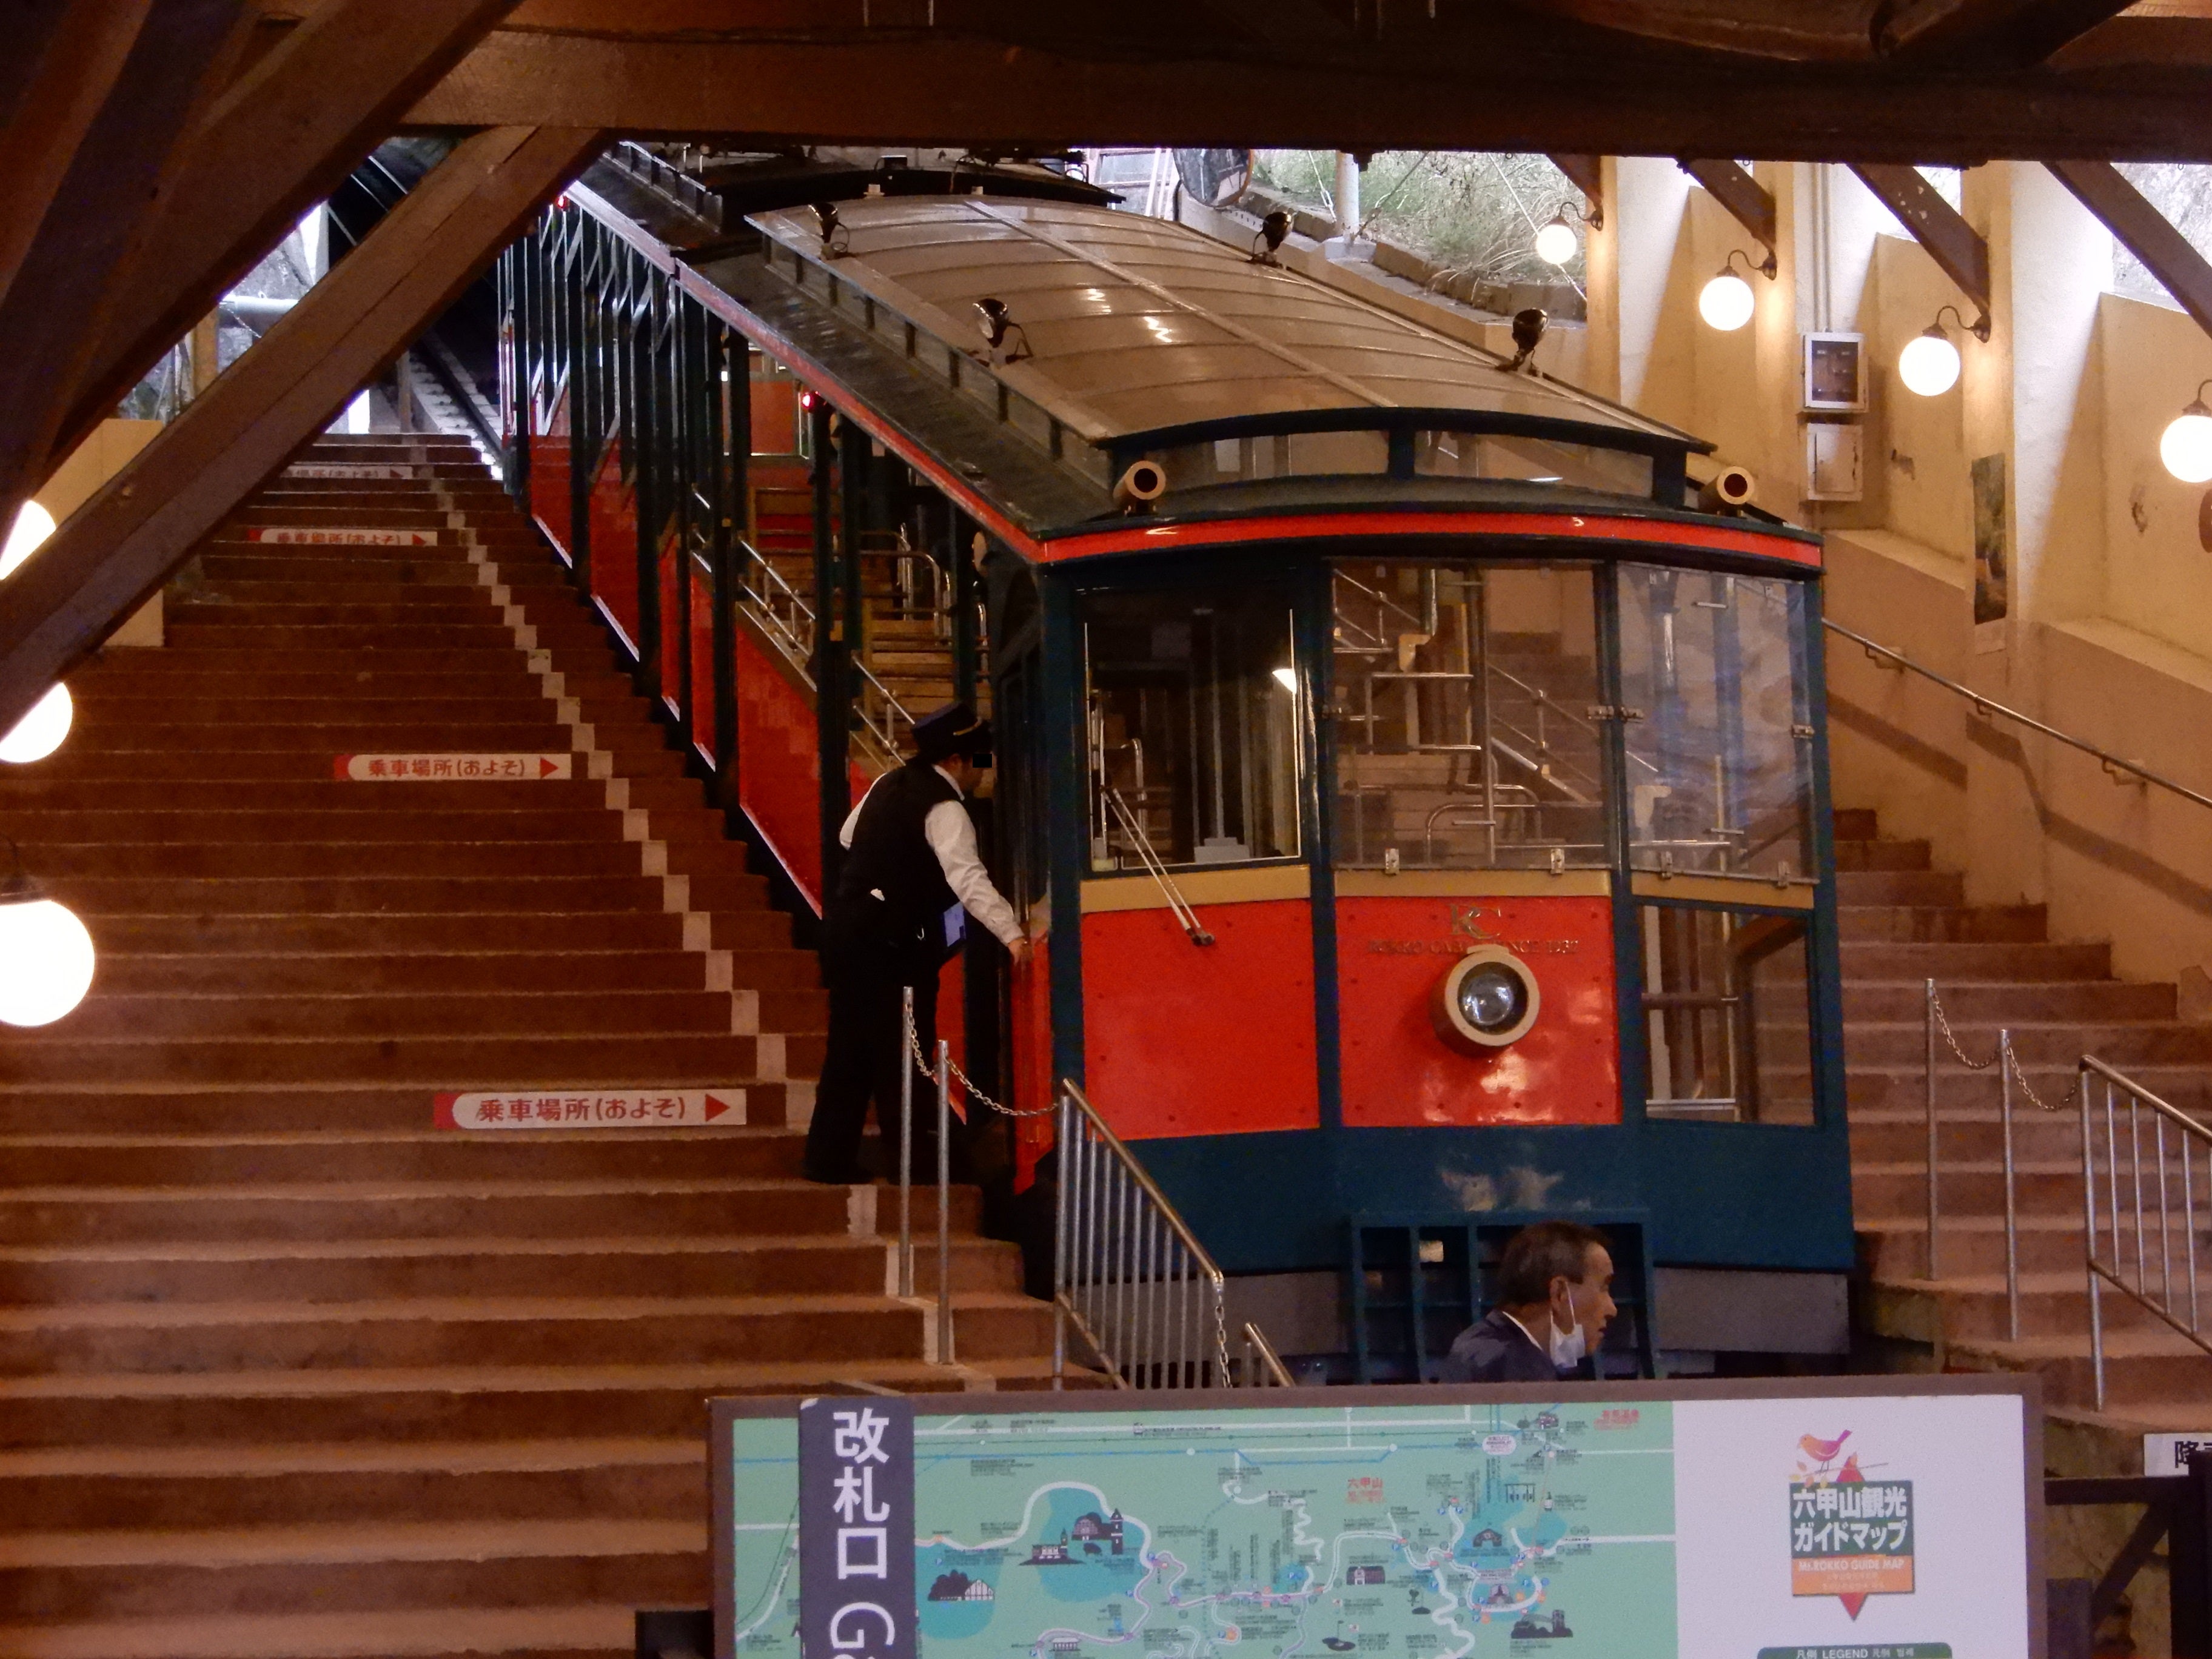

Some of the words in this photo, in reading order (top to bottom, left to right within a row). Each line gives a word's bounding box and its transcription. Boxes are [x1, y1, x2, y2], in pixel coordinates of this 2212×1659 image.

[367, 758, 526, 777] 乗車場所(およそ)
[477, 1096, 686, 1123] 乗車場所(およそ)
[832, 1407, 890, 1580] 改札口
[1793, 1486, 1908, 1519] 六甲山観光
[1794, 1520, 1908, 1552] ガイドマップ
[1822, 1648, 1868, 1658] LEGEND
